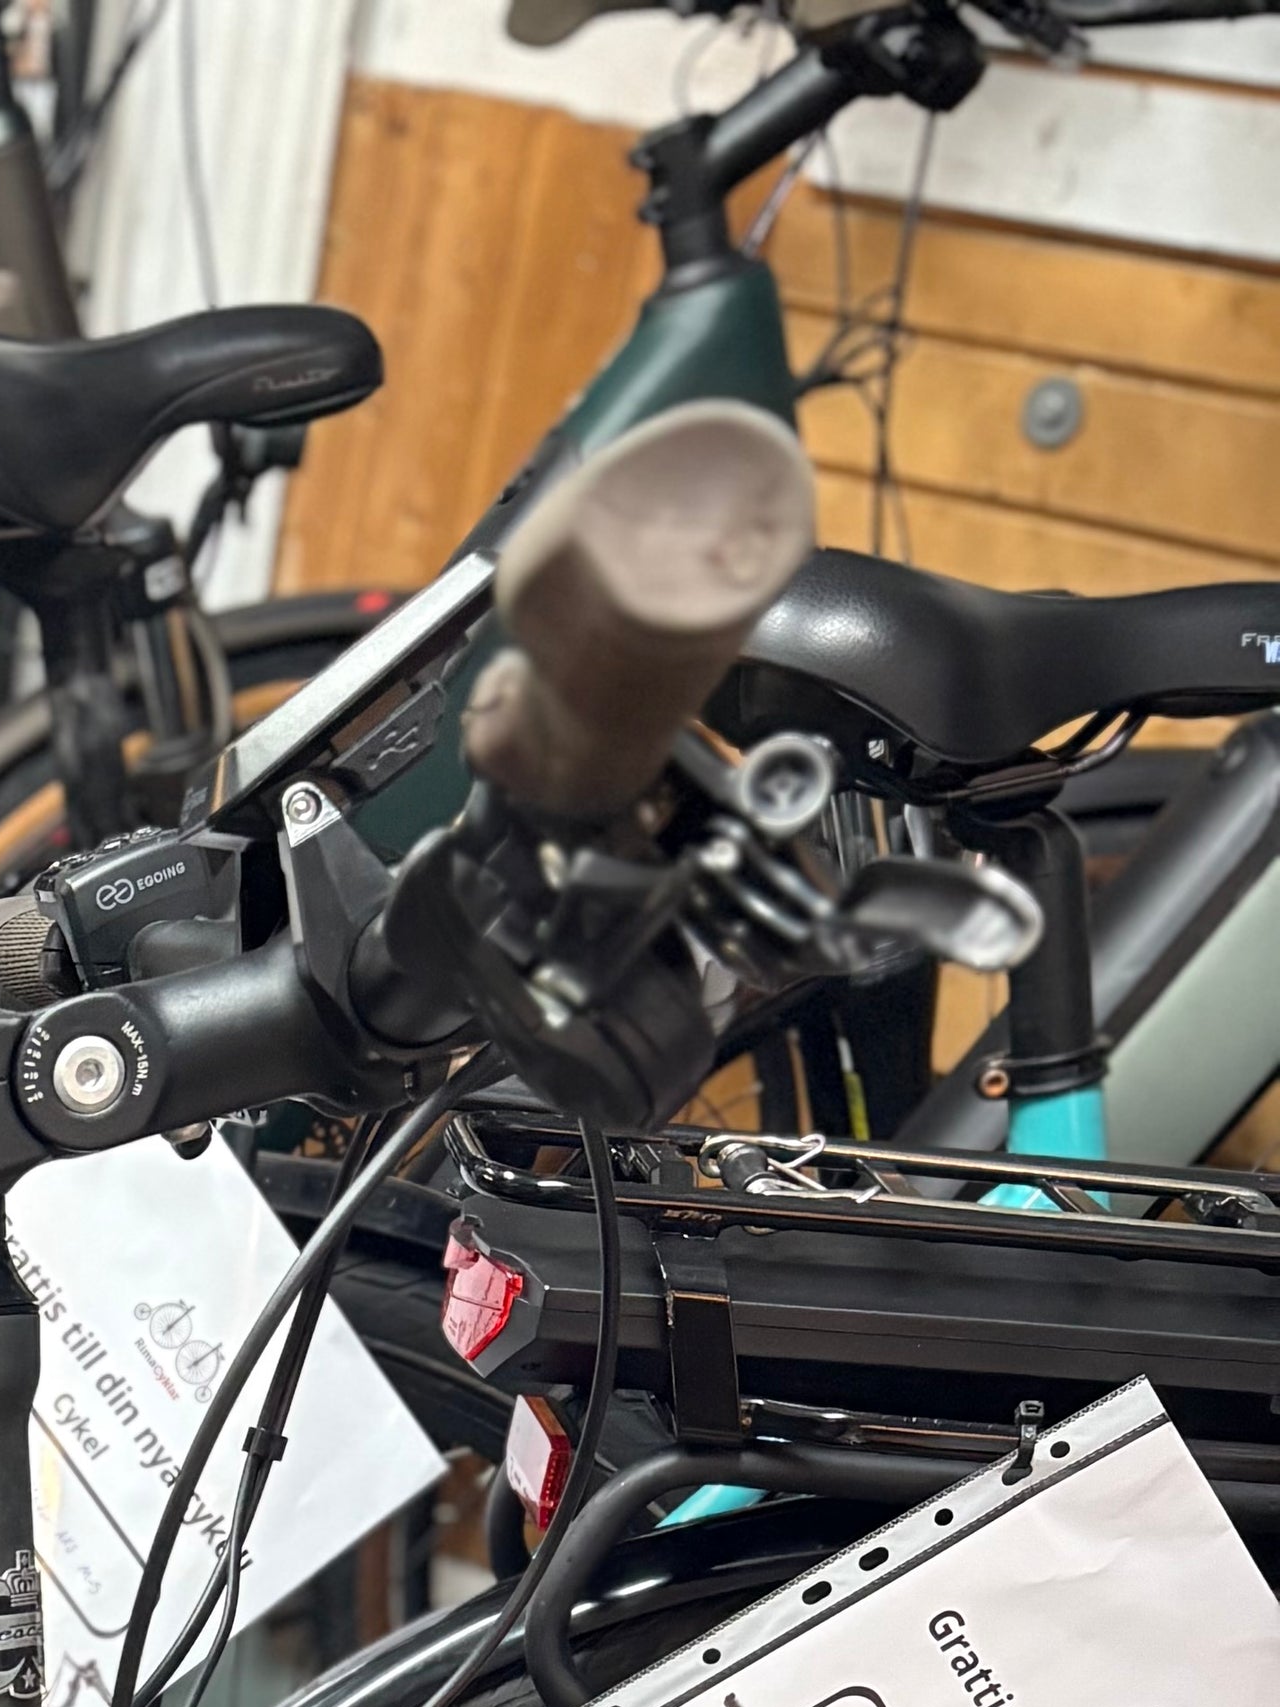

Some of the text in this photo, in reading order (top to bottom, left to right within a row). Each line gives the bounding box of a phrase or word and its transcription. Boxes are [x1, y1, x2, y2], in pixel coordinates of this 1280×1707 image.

[136, 861, 186, 891] EGOING
[5, 1216, 68, 1323] rattis
[60, 1321, 109, 1372] till
[95, 1371, 140, 1428] din
[133, 1426, 183, 1489] nya
[52, 1391, 111, 1462] Cykel
